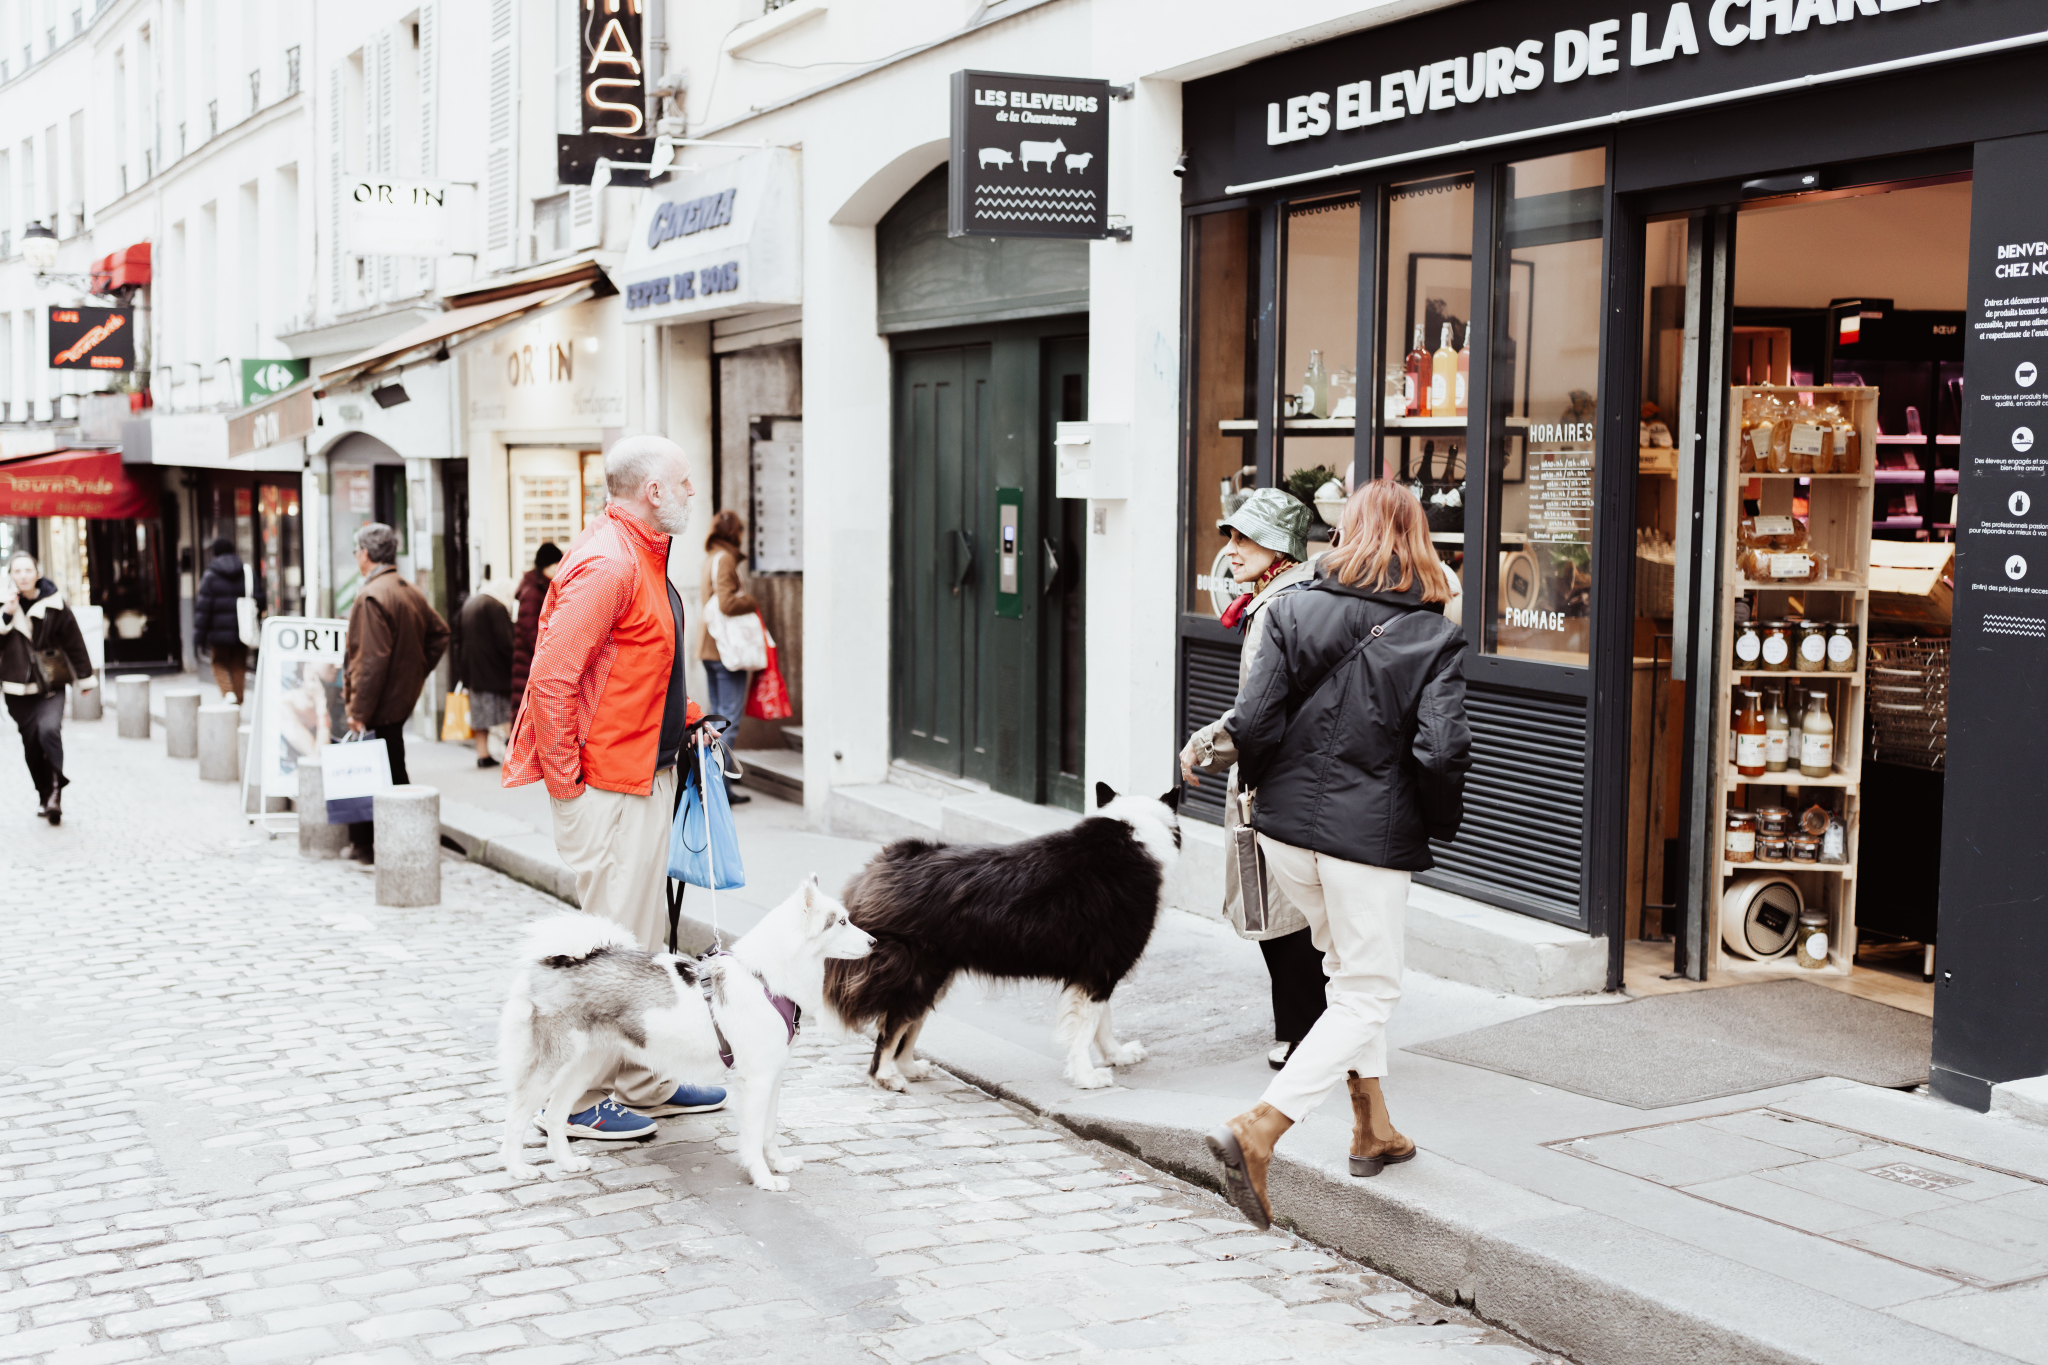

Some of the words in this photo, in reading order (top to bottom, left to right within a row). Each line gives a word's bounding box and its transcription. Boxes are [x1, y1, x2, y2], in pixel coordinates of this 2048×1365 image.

[582, 0, 642, 134] AS
[1267, 91, 1331, 146] LES
[1336, 38, 1545, 131] ELEVEURS
[1553, 18, 1621, 83] DE
[1630, 2, 1700, 66] LA
[975, 89, 1007, 107] LES
[1010, 91, 1098, 113] ELEVEURS
[996, 110, 1009, 122] de
[1009, 111, 1020, 123] la
[1995, 262, 2029, 278] CHEZ
[674, 271, 695, 301] DE
[701, 261, 738, 296] BOIS
[1984, 298, 2003, 307] Entrez
[2003, 298, 2010, 306] et
[2010, 296, 2040, 306] découvrez
[1985, 309, 1993, 318] de
[1993, 308, 2018, 319] produits
[2018, 307, 2039, 316] locaux
[2005, 319, 2019, 329] pour
[2020, 319, 2031, 327] une
[1979, 332, 1986, 340] et
[1986, 331, 2021, 341] respectueuse
[2023, 329, 2030, 338] de
[2020, 393, 2041, 401] produits
[1529, 423, 1593, 443] HORAIRES
[2008, 457, 2031, 466] engagés
[1981, 520, 1991, 528] Des
[1991, 521, 2028, 529] professionnels
[1982, 527, 2007, 535] répondre
[1971, 583, 1987, 592] (Enfin)
[2008, 585, 2023, 593] justes
[1505, 607, 1565, 632] FROMAGE
